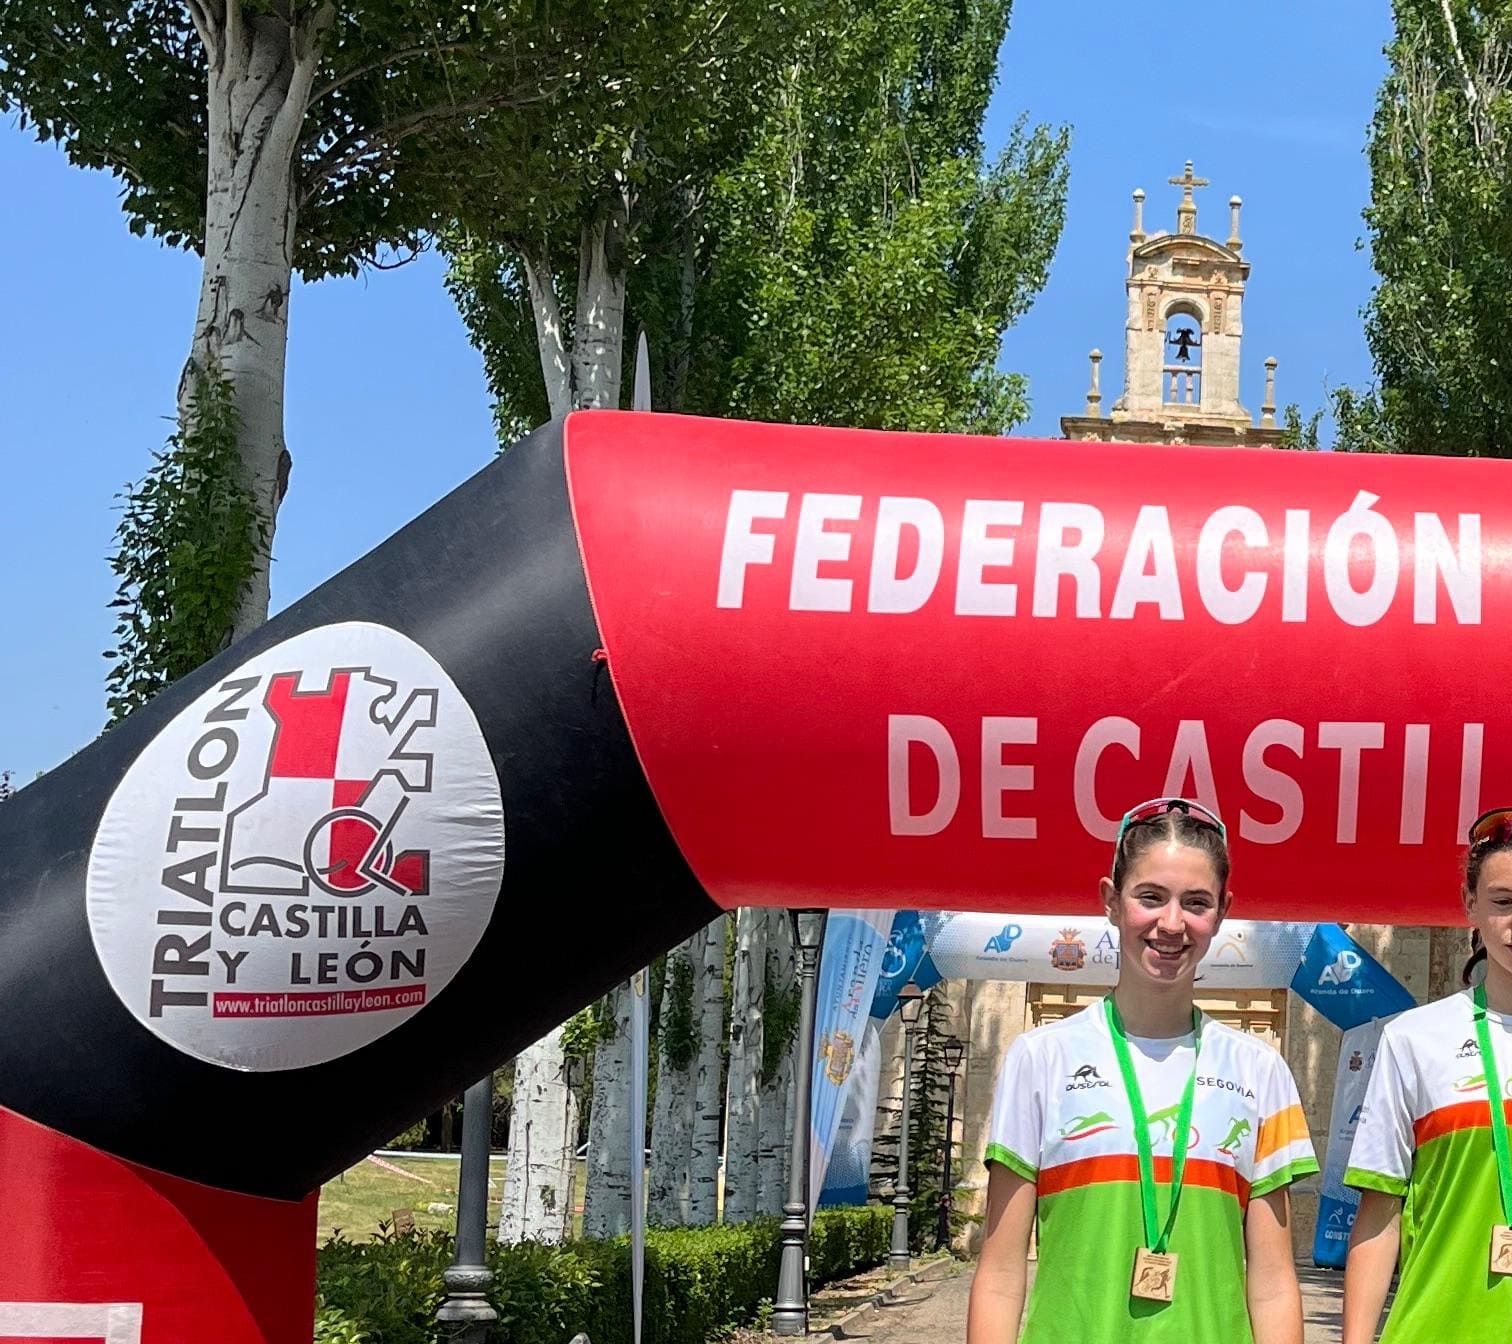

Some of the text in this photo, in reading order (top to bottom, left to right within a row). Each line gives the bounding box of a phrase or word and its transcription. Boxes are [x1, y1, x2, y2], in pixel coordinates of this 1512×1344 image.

[717, 489, 1481, 628] FEDERACIÓN
[888, 714, 1039, 839] DE
[149, 675, 262, 1018] TRIATLON
[218, 900, 428, 939] CASTILLA
[217, 940, 426, 985] Y LEÓN
[216, 987, 424, 1015] www.triatloncastillayleon.com
[1196, 1076, 1256, 1100] SEGOVIA
